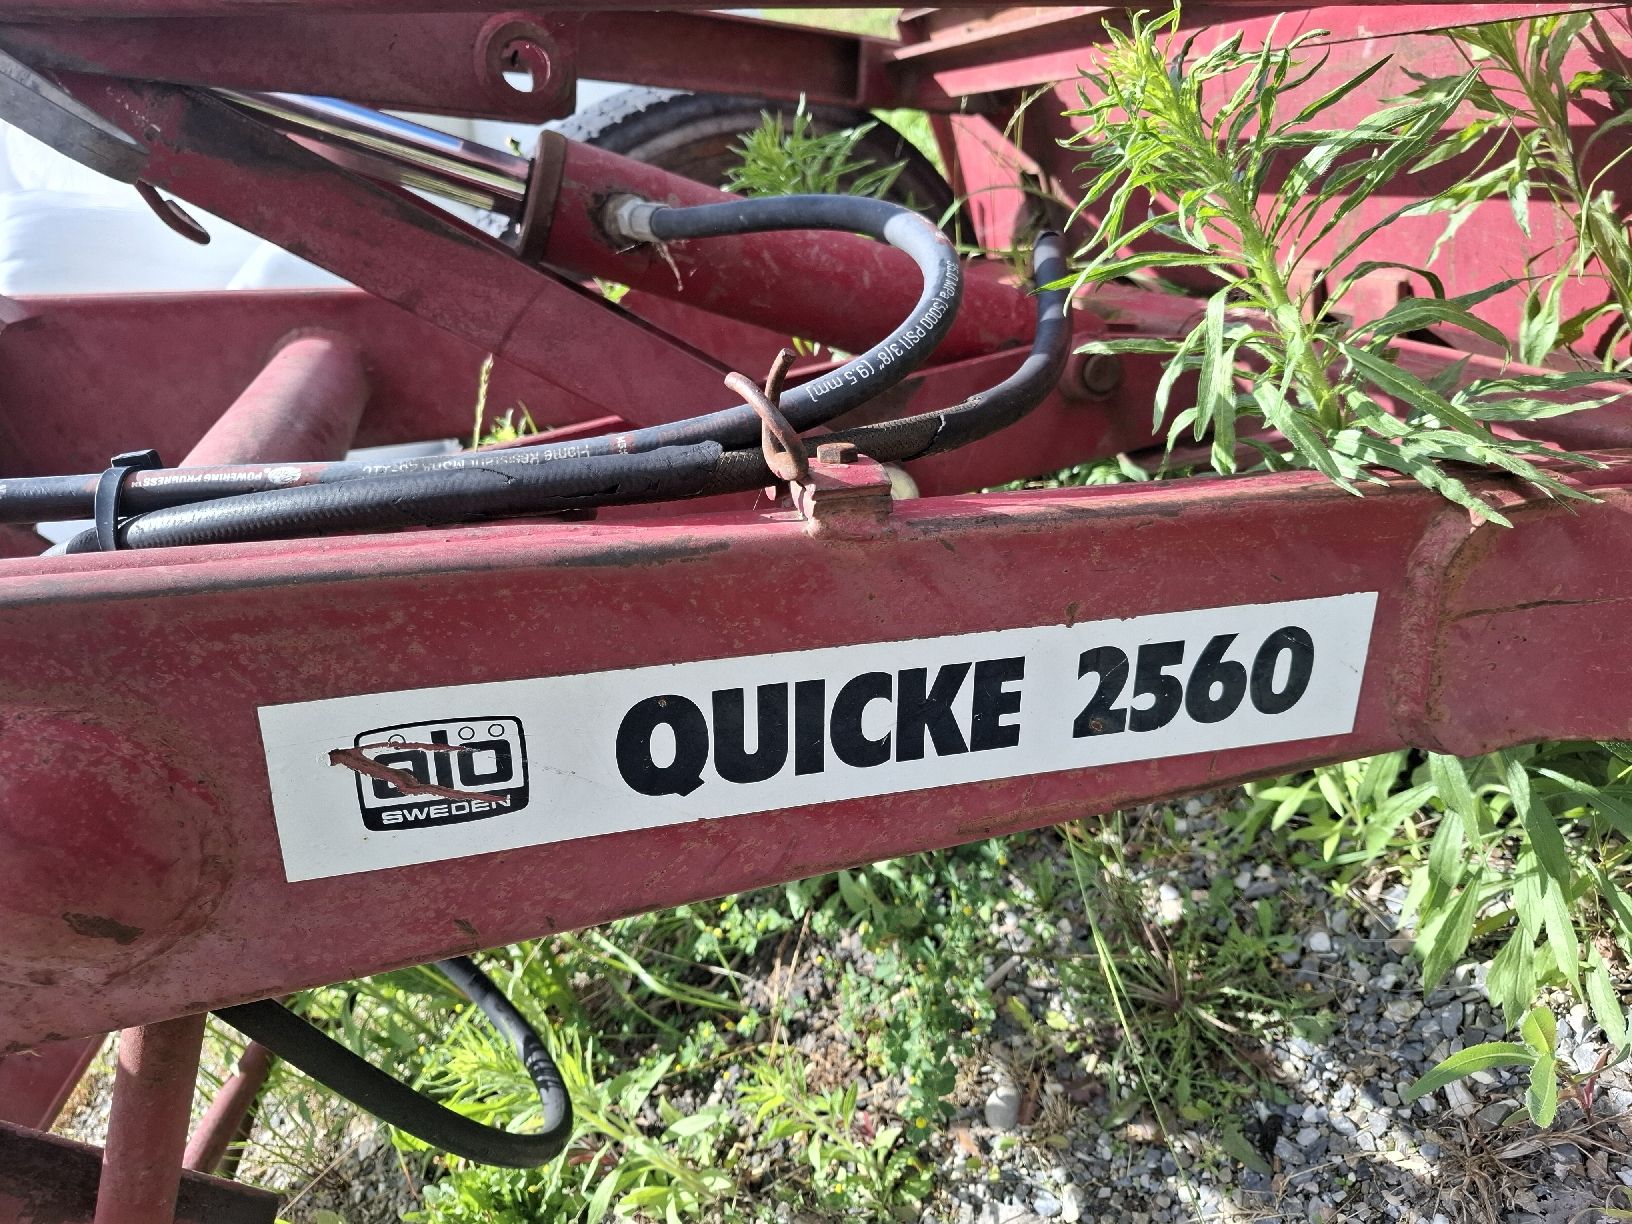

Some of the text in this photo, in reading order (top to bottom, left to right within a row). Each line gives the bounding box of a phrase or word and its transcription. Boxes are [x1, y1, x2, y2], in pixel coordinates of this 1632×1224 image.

[939, 279, 958, 300] MPa
[616, 625, 1315, 797] QUICKE 2560
[382, 794, 512, 825] SWEDEN
